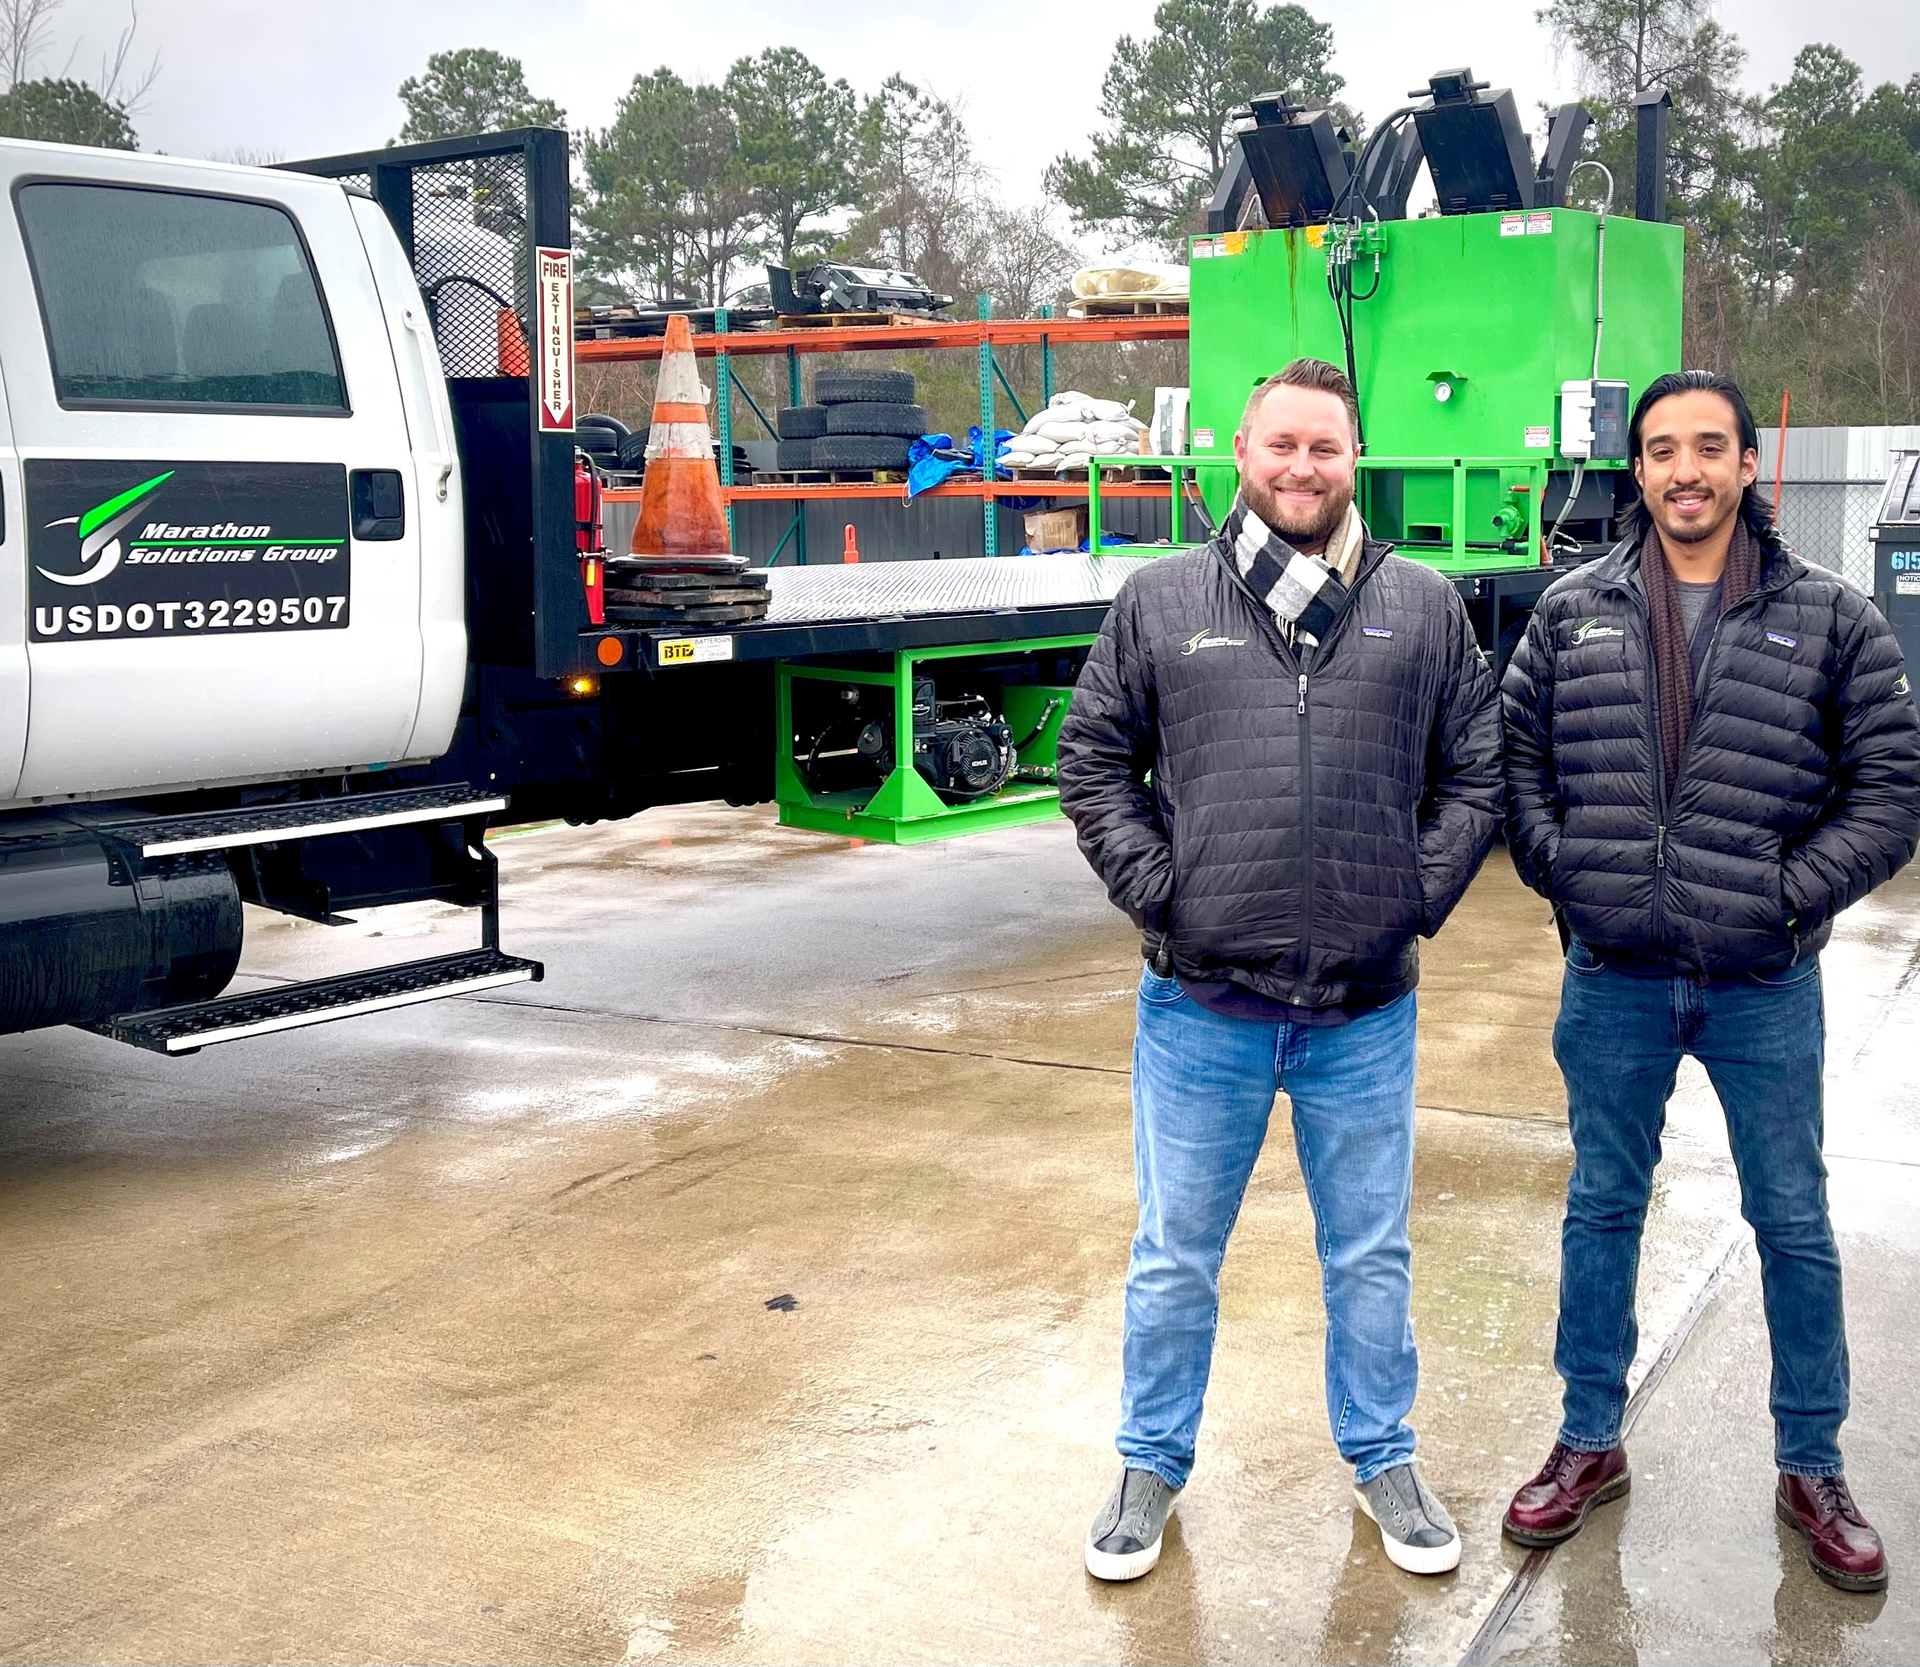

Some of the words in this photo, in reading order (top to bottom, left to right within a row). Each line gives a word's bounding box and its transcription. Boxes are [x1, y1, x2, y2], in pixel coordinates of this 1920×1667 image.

[543, 262, 567, 279] FIRE
[551, 282, 562, 411] EXTINGUISHER
[138, 522, 271, 539] Marathon
[124, 547, 256, 565] Solutions
[262, 545, 338, 564] Group
[34, 596, 347, 635] USDOT3229507
[695, 636, 731, 645] BATTERSON
